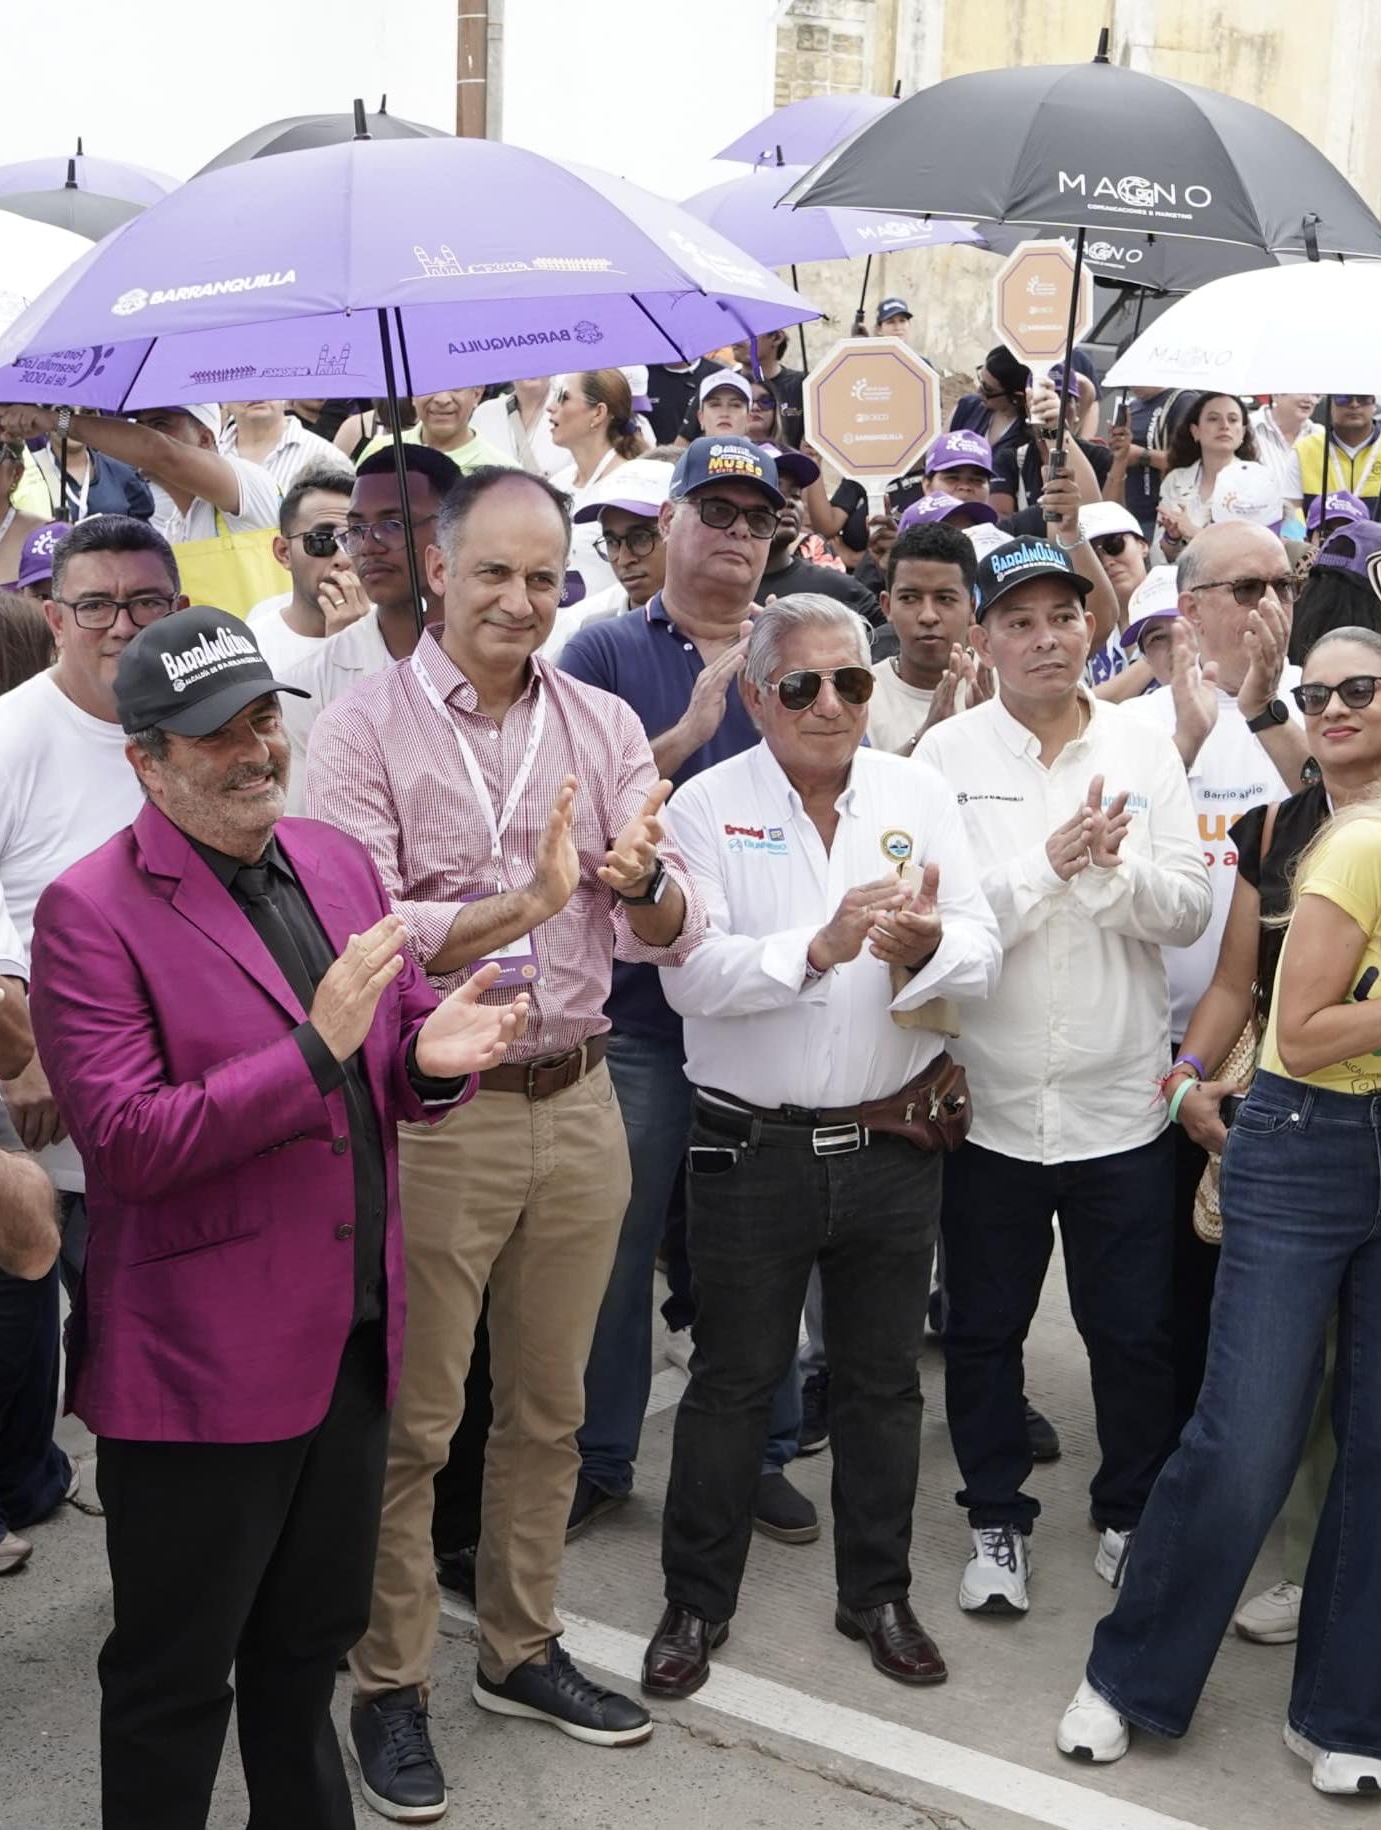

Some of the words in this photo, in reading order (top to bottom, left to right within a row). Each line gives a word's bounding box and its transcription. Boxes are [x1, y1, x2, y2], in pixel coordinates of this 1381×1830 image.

[1059, 171, 1212, 207] MAGNO
[857, 220, 933, 239] MAGNO
[149, 270, 296, 304] BARRANQUILLA
[1203, 789, 1236, 800] Barrio
